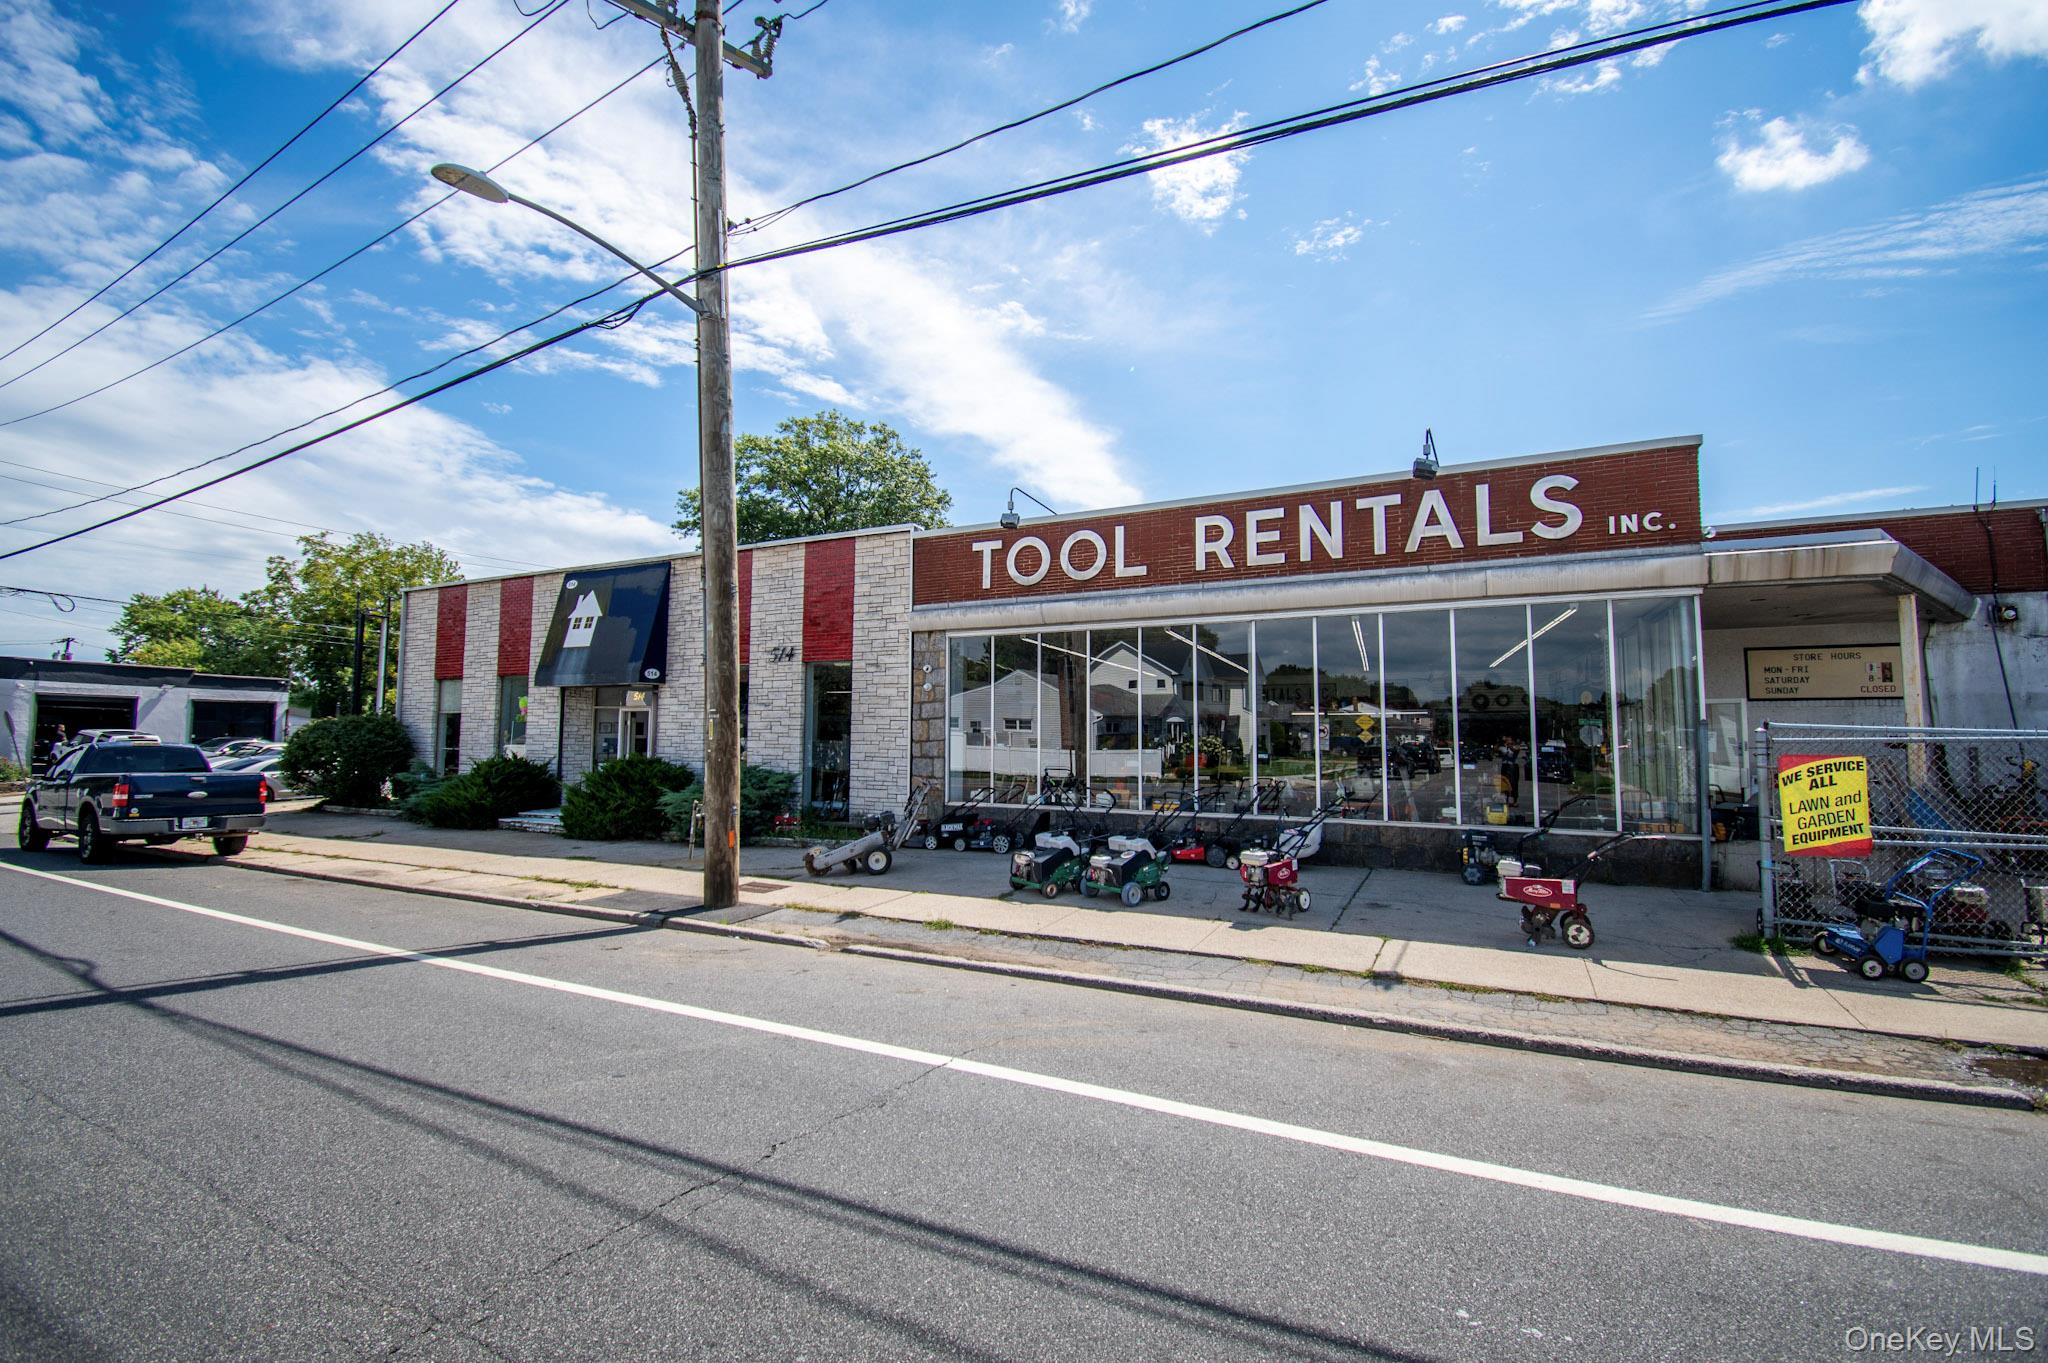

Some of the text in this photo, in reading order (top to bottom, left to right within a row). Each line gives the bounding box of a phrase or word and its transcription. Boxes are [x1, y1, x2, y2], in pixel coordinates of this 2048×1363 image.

[972, 474, 1678, 590] TOOL RENTALS INC.
[769, 646, 794, 663] 514
[1793, 651, 1862, 661] STORE HOURS
[1763, 665, 1783, 674] MON
[1791, 665, 1809, 674] FRI
[1764, 676, 1810, 684] SATURDAY
[1765, 686, 1799, 694] SUNDAY
[1860, 685, 1897, 693] CLOSED
[1781, 760, 1864, 786] WE SERVICE
[1808, 775, 1837, 790] ALL
[1789, 790, 1862, 815] LAWN and
[1797, 808, 1856, 830] GARDEN
[1792, 822, 1864, 845] EQUIPMENT
